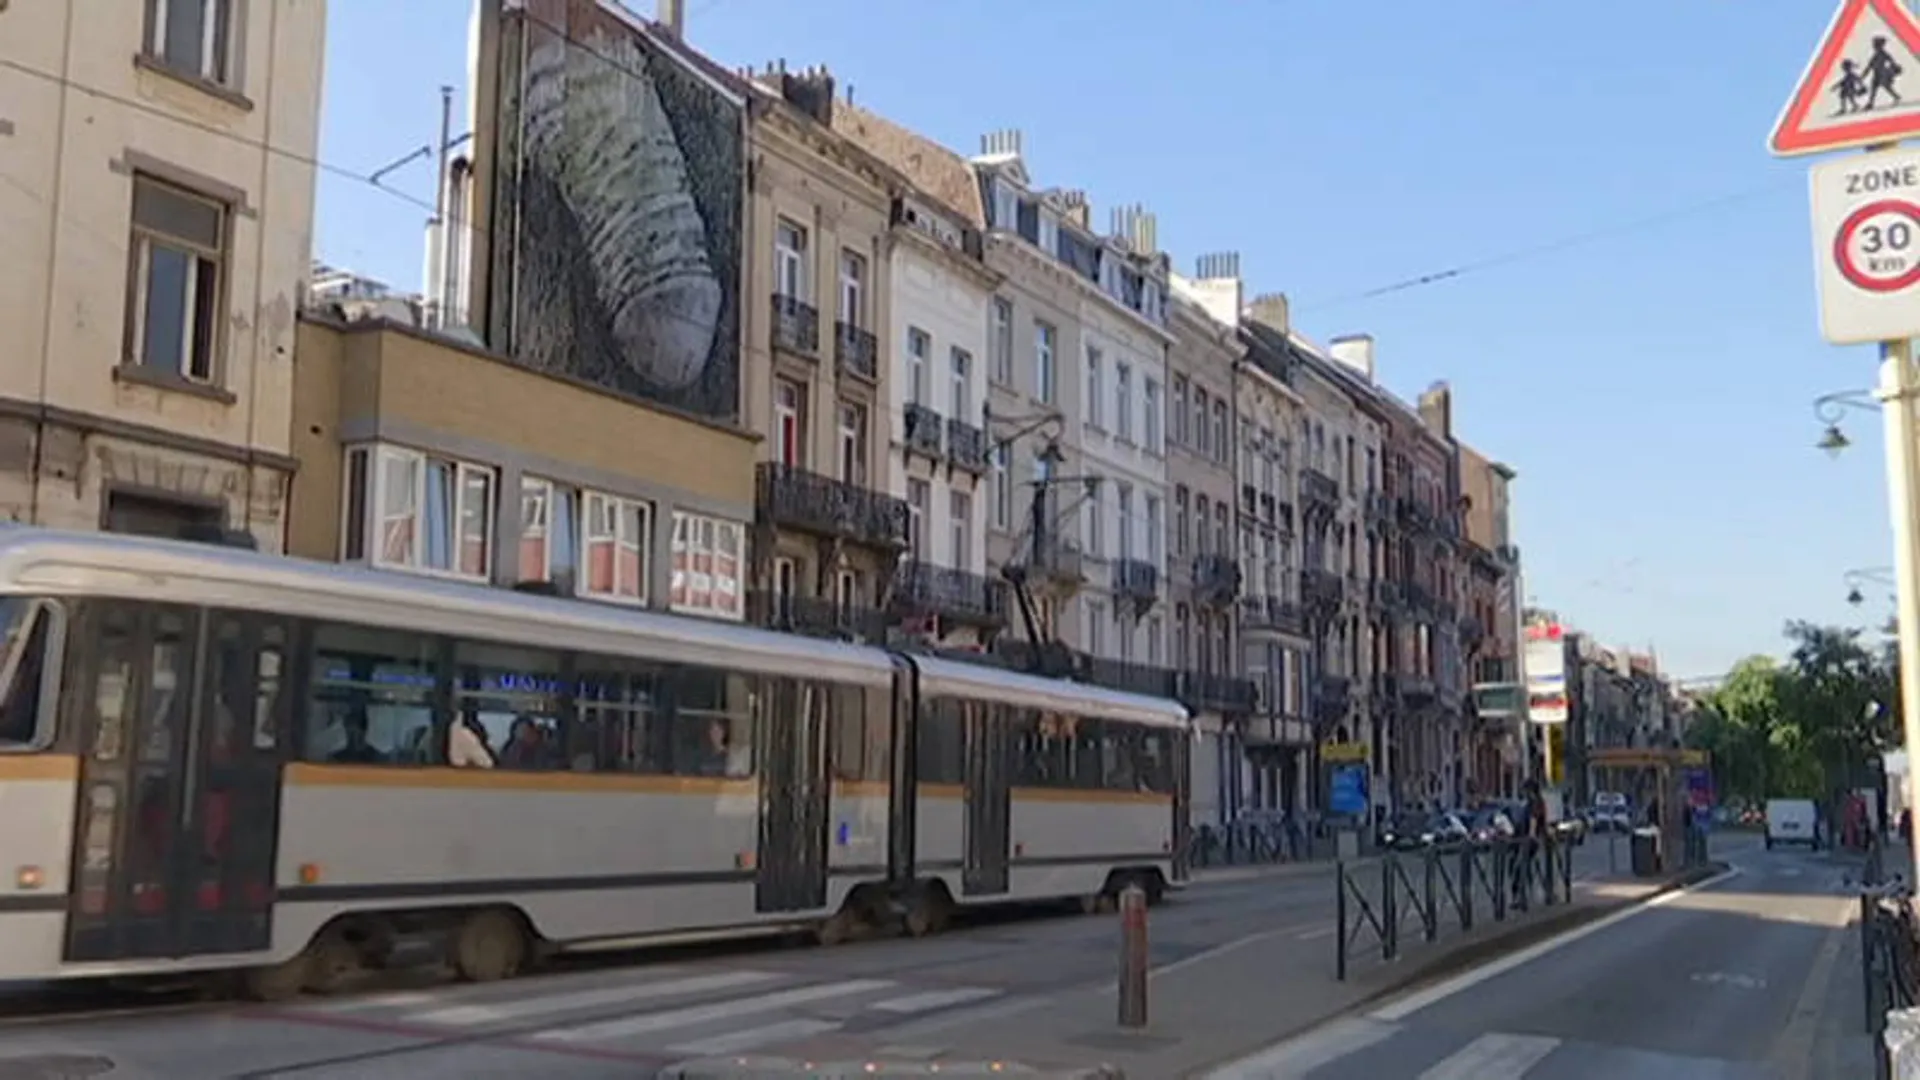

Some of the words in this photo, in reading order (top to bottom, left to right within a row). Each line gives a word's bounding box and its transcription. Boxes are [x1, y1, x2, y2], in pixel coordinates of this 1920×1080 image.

[1845, 166, 1918, 194] ZONE
[1861, 222, 1911, 253] 30
[1868, 256, 1907, 272] km
